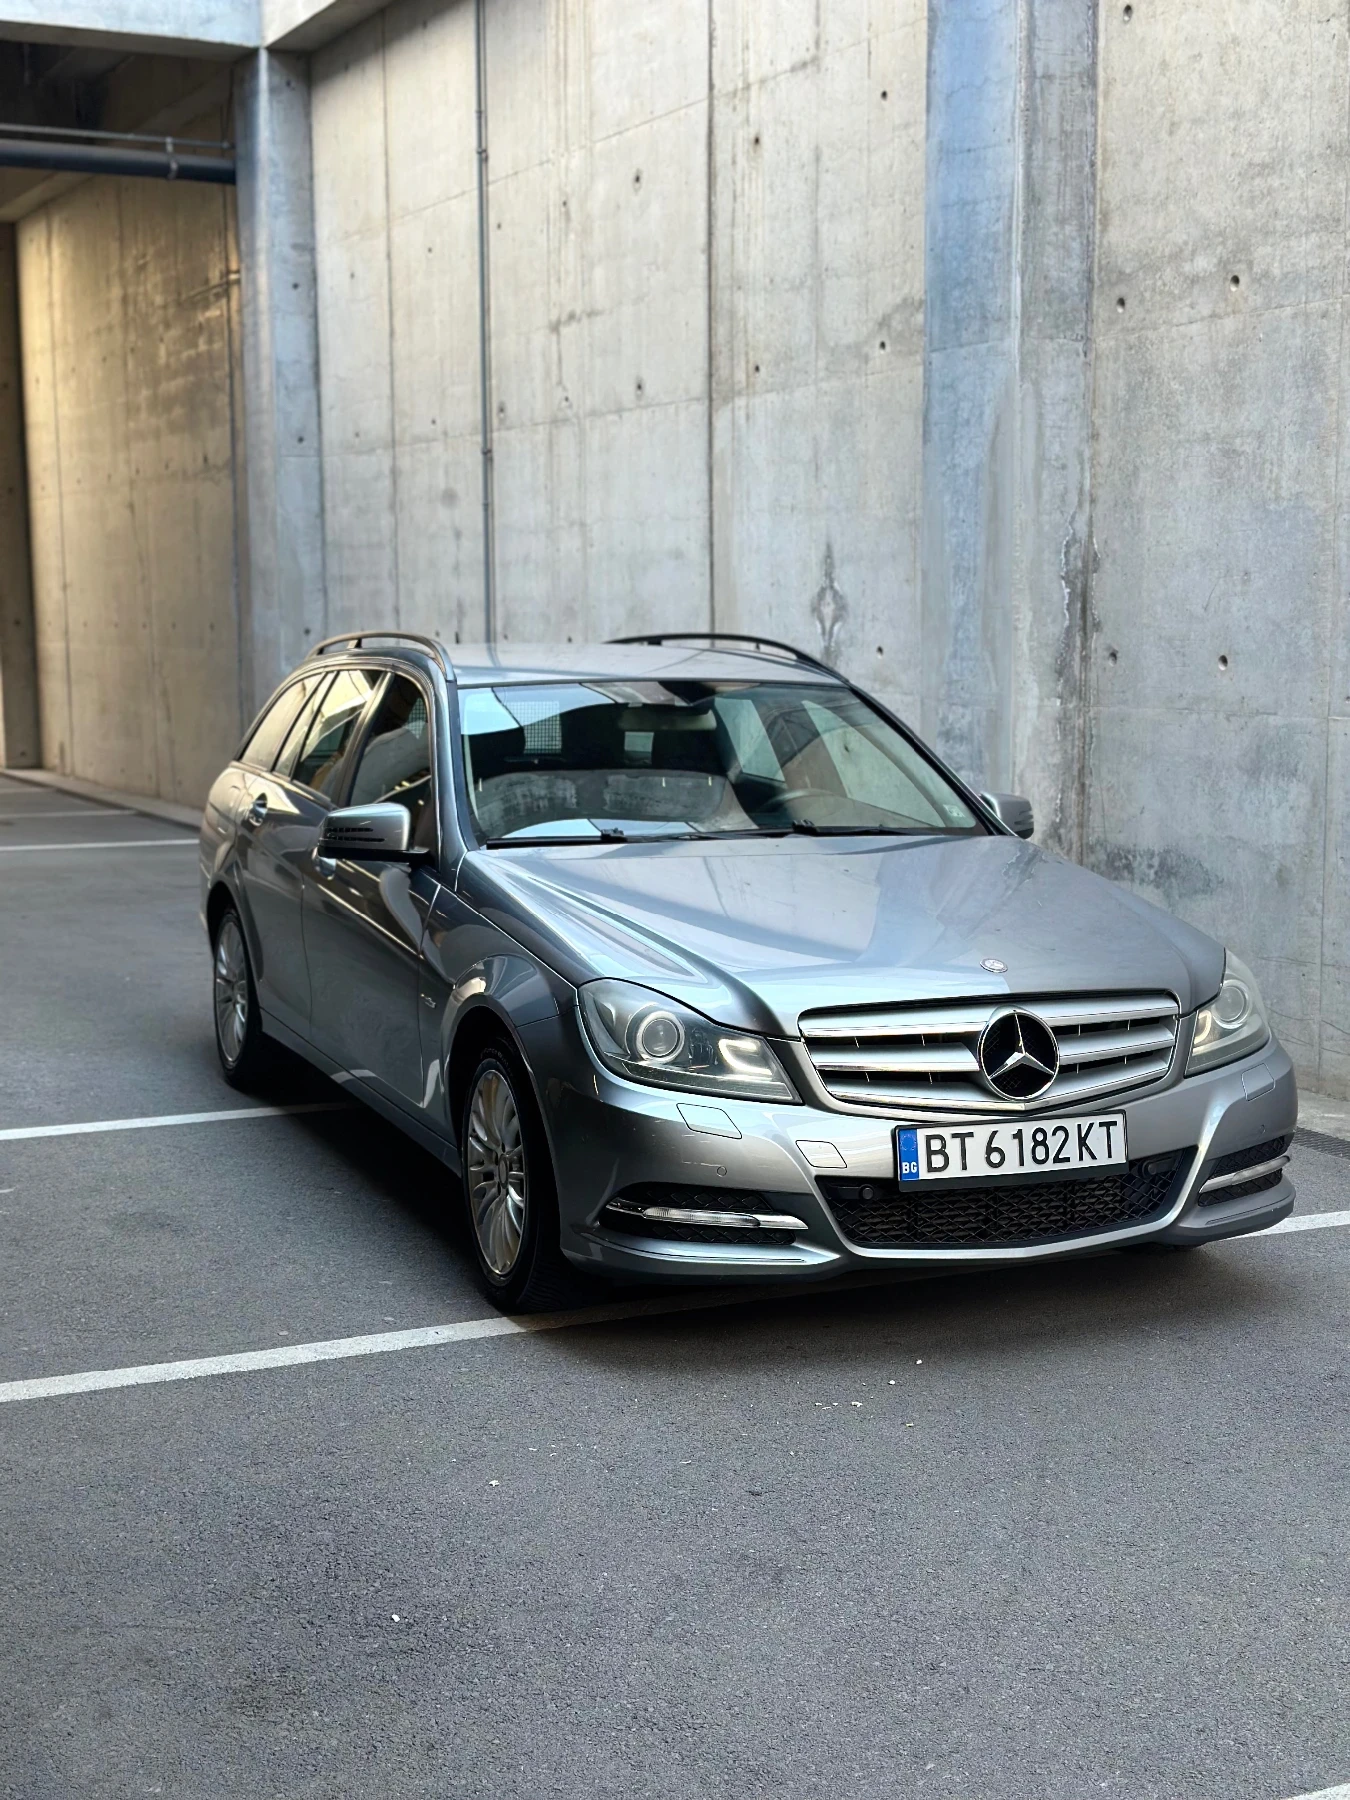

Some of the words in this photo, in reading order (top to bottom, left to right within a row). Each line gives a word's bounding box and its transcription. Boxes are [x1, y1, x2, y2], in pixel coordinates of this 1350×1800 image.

[925, 1131, 974, 1173] BT
[985, 1125, 1071, 1168] 6182
[1077, 1120, 1118, 1162] KT
[902, 1162, 918, 1174] BG
